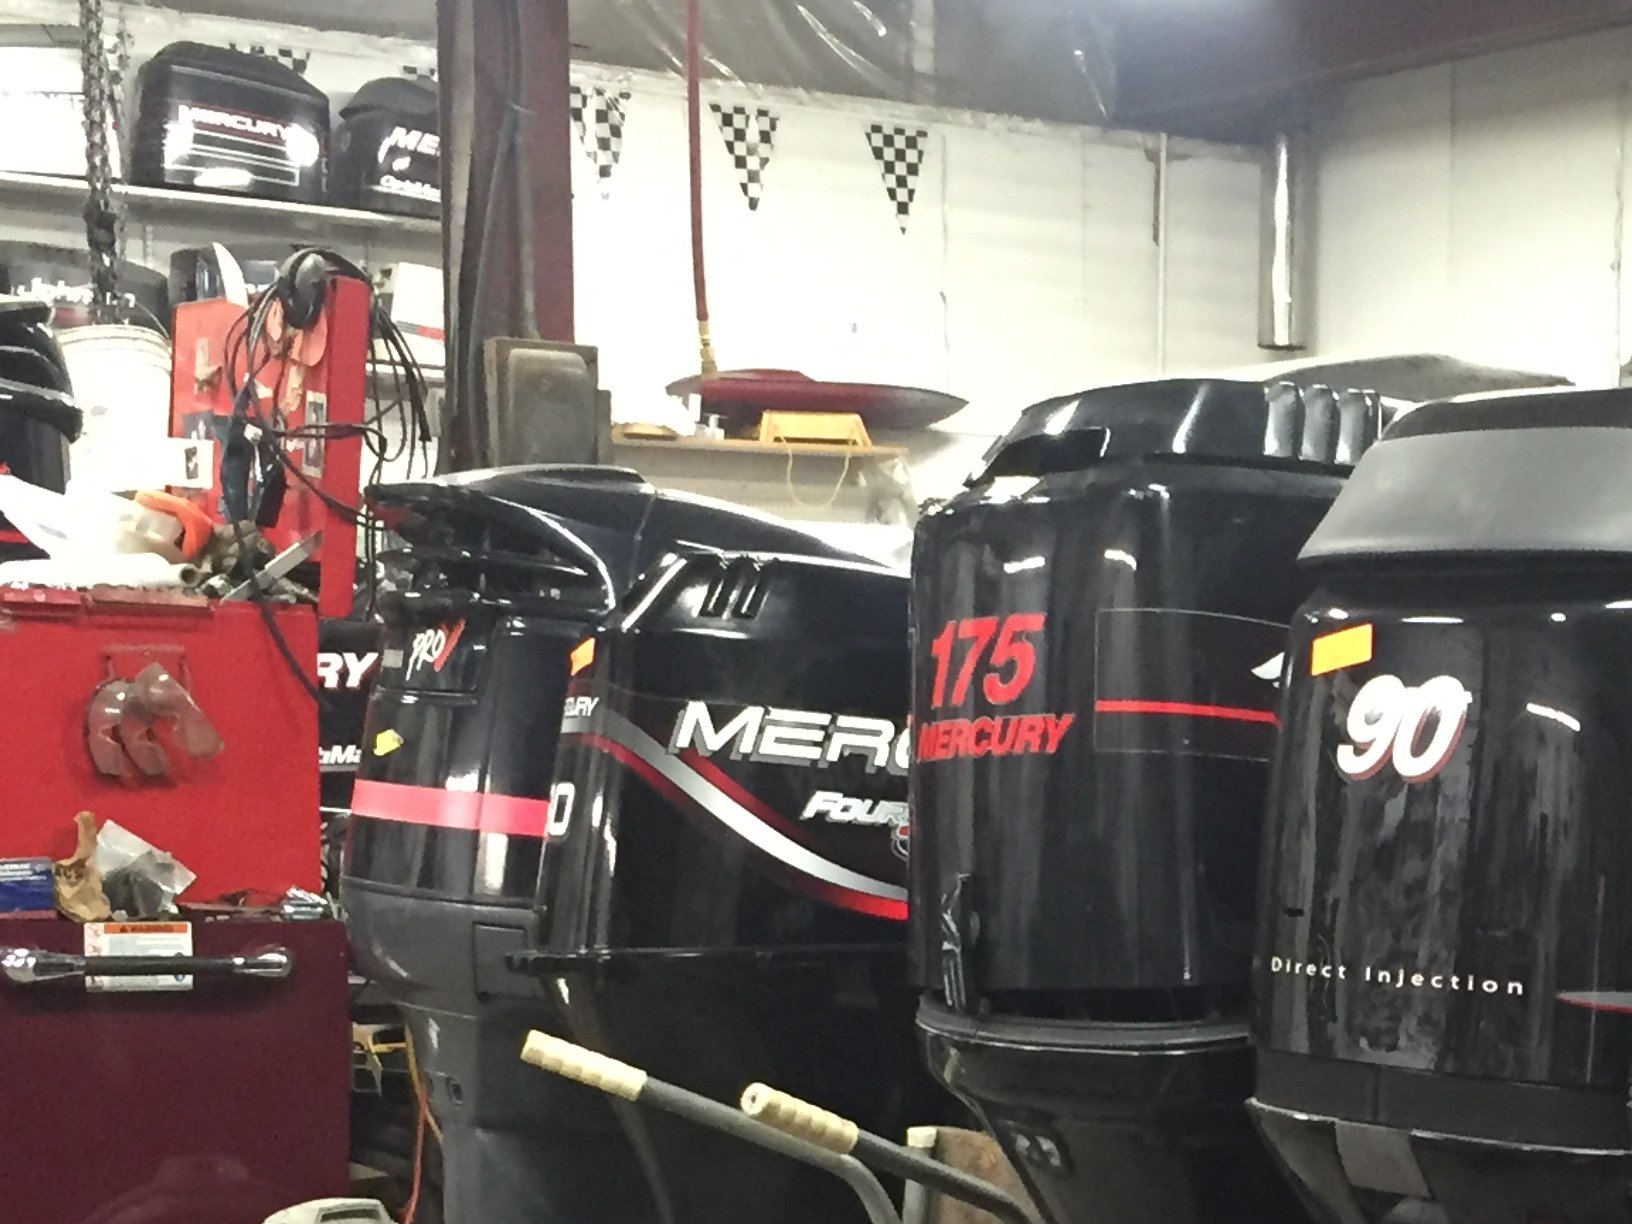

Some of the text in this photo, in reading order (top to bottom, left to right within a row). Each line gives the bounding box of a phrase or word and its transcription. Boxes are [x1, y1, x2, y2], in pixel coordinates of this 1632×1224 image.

[390, 126, 441, 157] ME
[931, 613, 1046, 708] 175
[917, 713, 1076, 764] MERCURY
[1336, 674, 1473, 783] 90
[1270, 956, 1524, 996] Direct Injection
